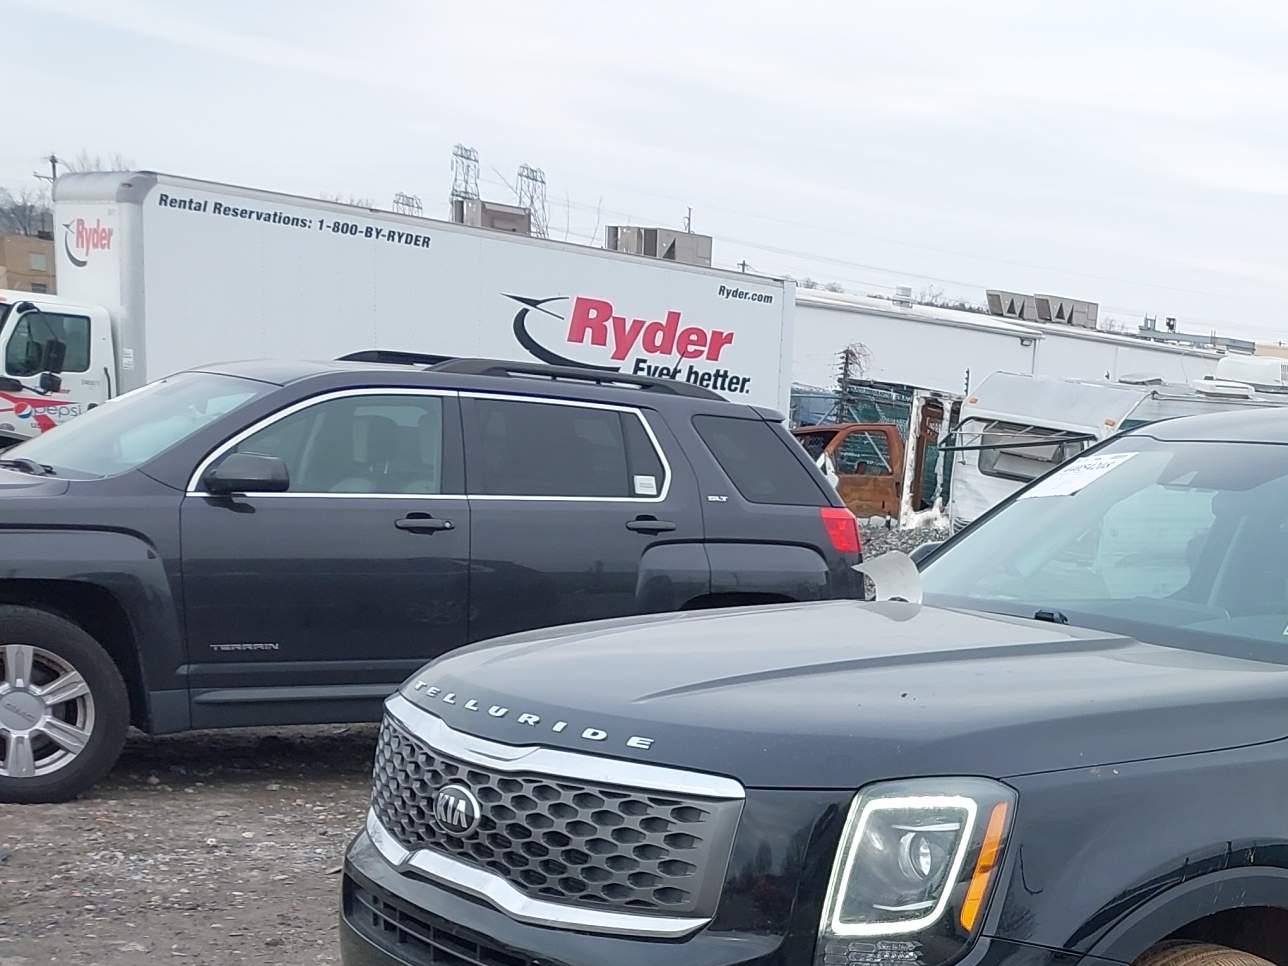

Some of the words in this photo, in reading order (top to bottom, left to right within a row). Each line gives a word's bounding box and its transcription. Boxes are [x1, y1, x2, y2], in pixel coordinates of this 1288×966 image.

[75, 218, 114, 257] Ryder
[158, 193, 207, 213] Rental
[212, 202, 313, 229] Reservations:
[318, 219, 431, 249] 1-800-BY-RYDER
[718, 285, 773, 304] Ryder.com
[567, 297, 735, 361] Ryder
[414, 680, 655, 750] TELLURIDE
[436, 792, 469, 829] KIA
